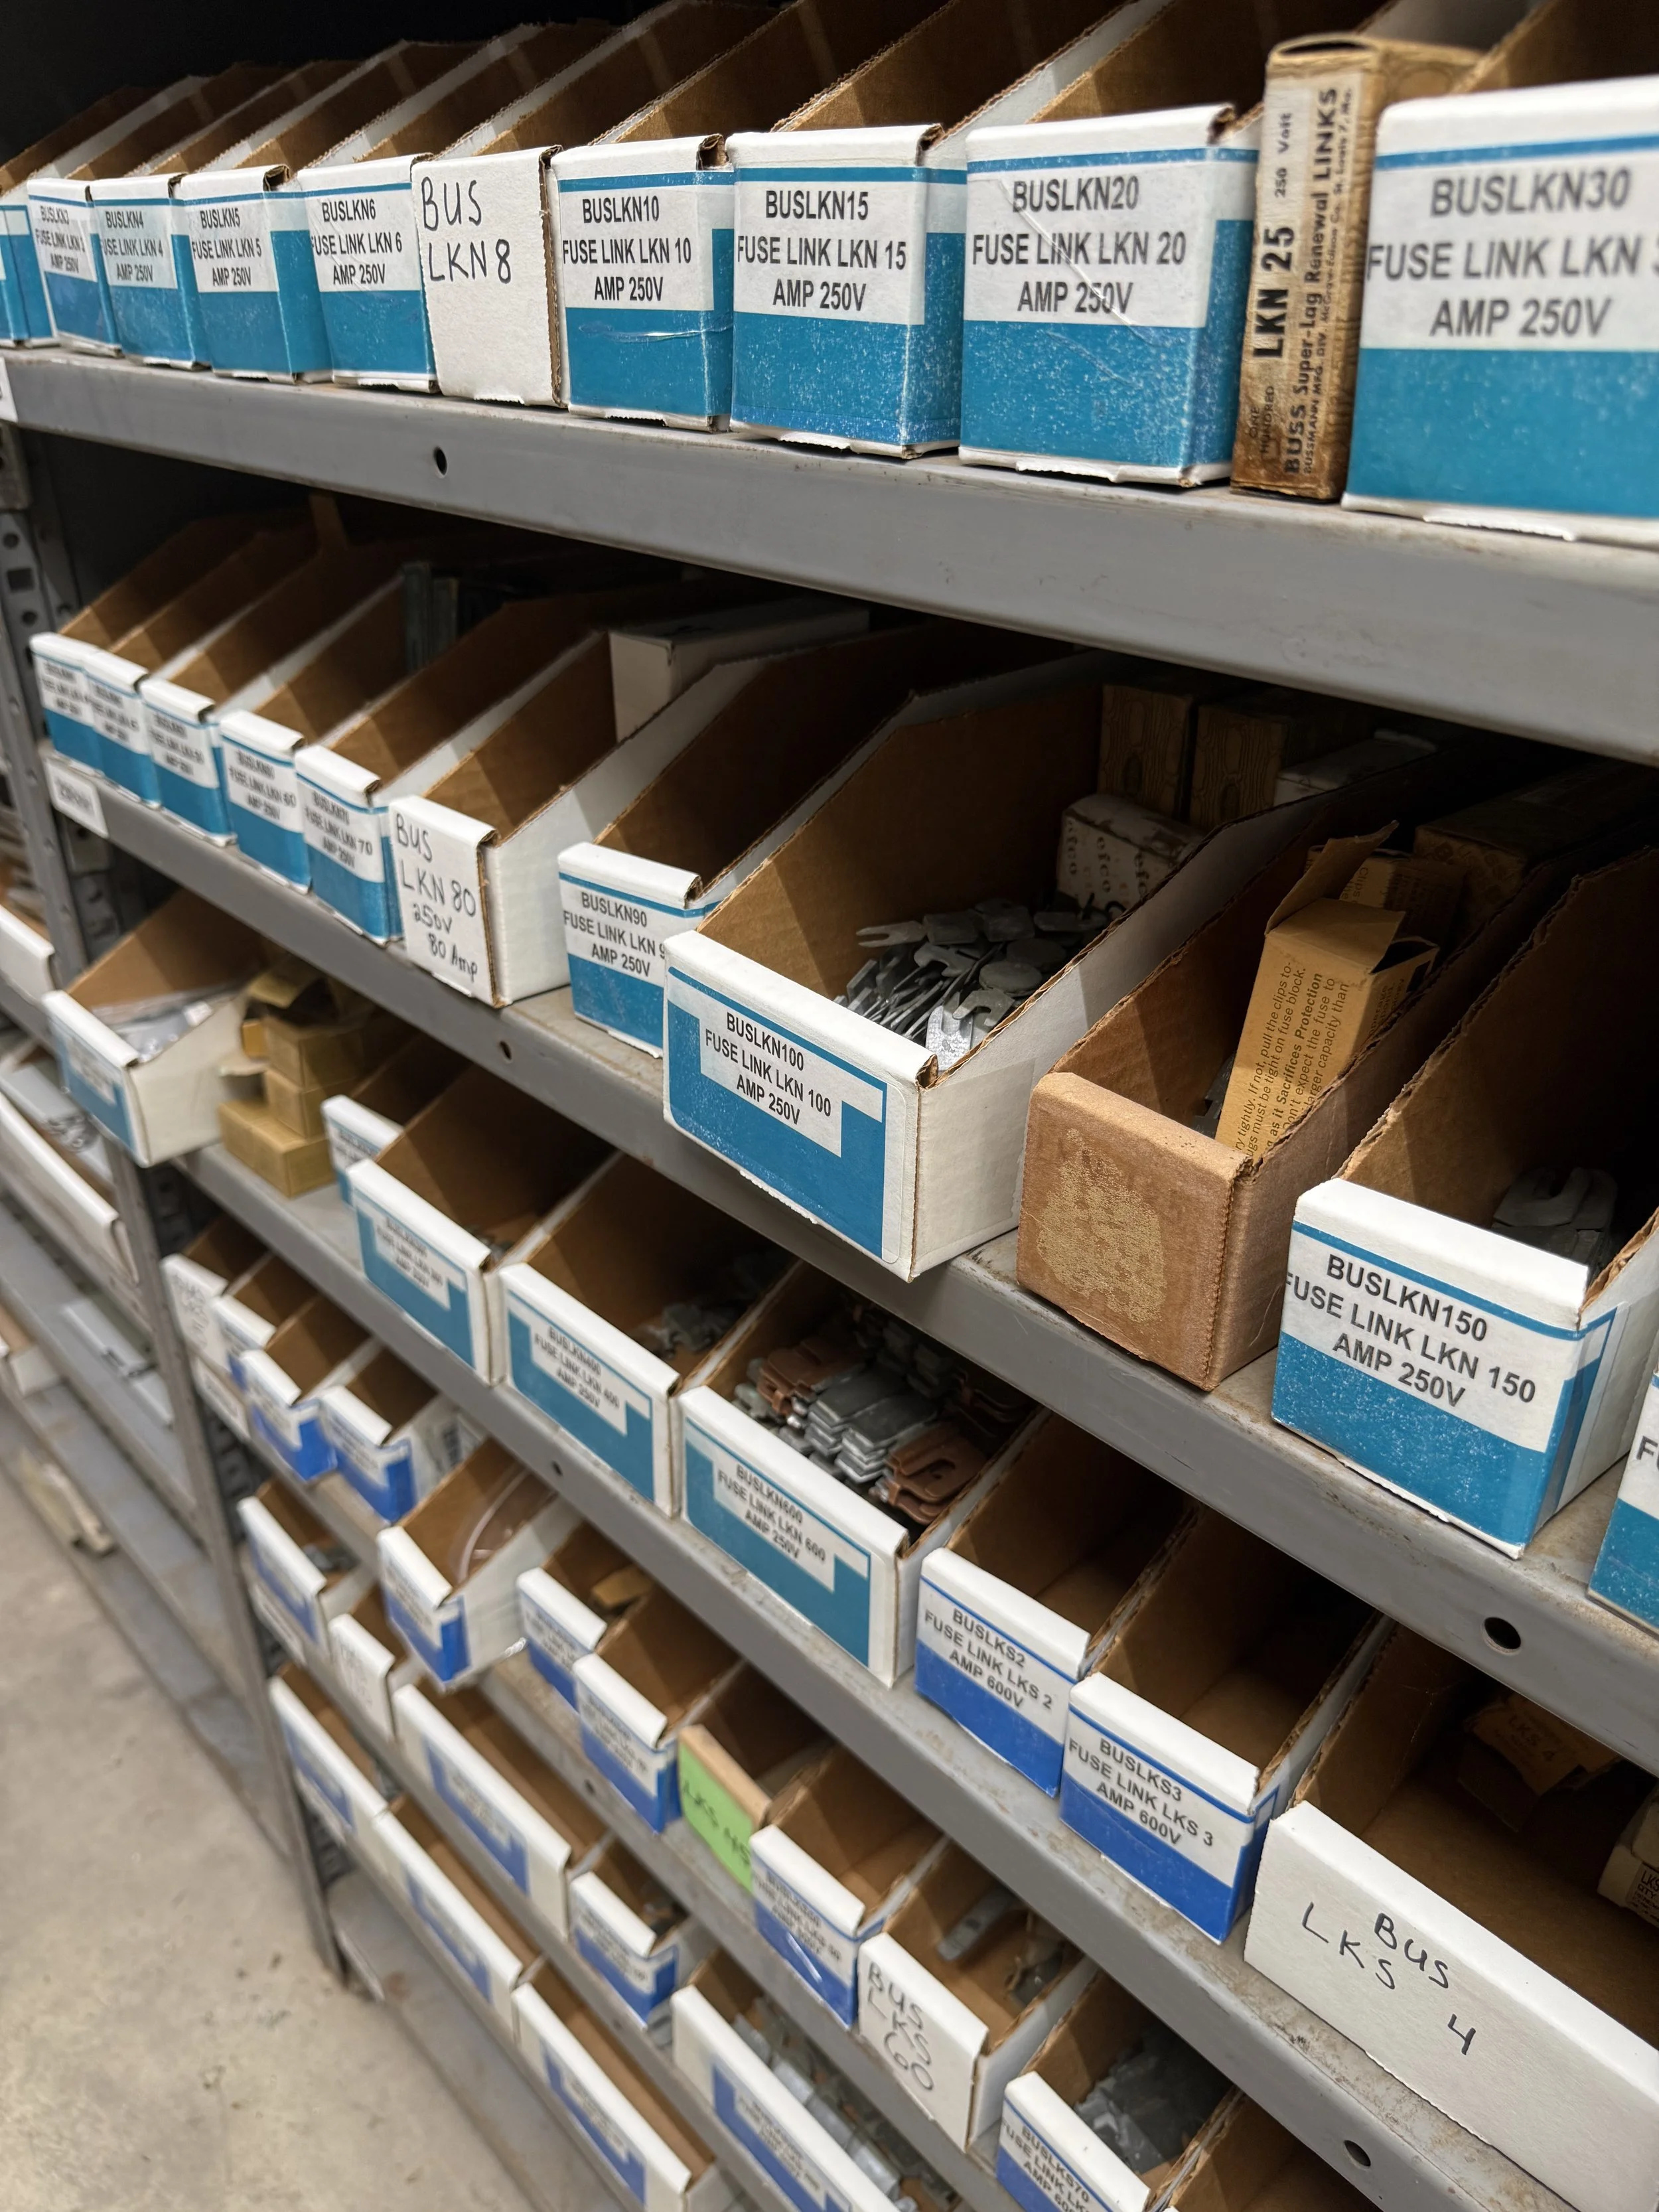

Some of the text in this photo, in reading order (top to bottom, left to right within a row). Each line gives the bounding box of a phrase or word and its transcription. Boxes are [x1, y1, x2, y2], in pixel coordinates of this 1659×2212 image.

[322, 198, 376, 222] BUSLKN6
[421, 176, 482, 232] BUS
[583, 195, 660, 224] BUSLKN10
[766, 189, 869, 220] BUSLKN15
[1012, 175, 1139, 213] BUSLKN20
[1429, 167, 1632, 217] BUSLKN30
[106, 210, 143, 229] BUSLKN4
[200, 207, 240, 229] BUSLKN5
[1253, 112, 1295, 358] LKN 25 250 Volt
[51, 231, 66, 248] LINK
[66, 234, 80, 250] LKN
[119, 240, 138, 256] LINK
[139, 240, 157, 257] LKN
[158, 242, 163, 258] 4
[192, 238, 262, 259] FUSE LINK LKN 5
[338, 233, 366, 255] LINK
[368, 232, 393, 254] LKN
[396, 232, 402, 252] 6
[562, 237, 691, 265] FUSE LINK LKN 10
[737, 235, 907, 270] FUSE LINK LKN 15
[972, 230, 1187, 266] FUSE LINK LKN 20
[1366, 242, 1453, 282] FUSE
[1464, 240, 1548, 279] LINK
[1560, 236, 1642, 276] LKN
[117, 265, 153, 281] AMP 250V
[212, 267, 252, 286] AMP 250V
[333, 263, 386, 285] AMP 250V
[595, 275, 664, 301] AMP 250V
[1284, 88, 1338, 474] BUSS Super-Lag Renewal LINKS
[772, 278, 867, 311] AMP 250V
[1017, 281, 1133, 314] AMP 250V
[1429, 297, 1613, 337] AMP 250V
[1303, 400, 1320, 475] BUSSMANN
[396, 812, 433, 863] BUS
[400, 859, 477, 917] LKN 80
[581, 891, 648, 928] BUSLKN90
[563, 911, 656, 957] FUSE LINK LKN
[427, 932, 478, 983] 80 Amp
[591, 942, 651, 978] AMP 250V
[1272, 980, 1287, 1011] clips
[1323, 978, 1335, 992] to
[1265, 1010, 1279, 1033] the
[1294, 973, 1323, 1041] Protection
[1313, 995, 1331, 1025] fuse
[1318, 1013, 1342, 1069] capacity
[1332, 983, 1350, 1014] than
[726, 1011, 805, 1072] BUSLKN100
[1252, 968, 1306, 1132] must be tight on fuse block.
[1261, 1032, 1273, 1058] pull
[1307, 1029, 1321, 1051] the
[705, 1029, 832, 1118] FUSE LINK LKN 100
[1248, 1082, 1258, 1095] If
[1253, 1061, 1266, 1082] not,
[1276, 1044, 1303, 1105] Sacrifices
[1295, 1053, 1314, 1096] expect
[736, 1073, 801, 1126] AMP 250V
[1238, 1098, 1256, 1137] tightly.
[1271, 1108, 1284, 1119] it
[1269, 1120, 1281, 1137] as
[1326, 1253, 1488, 1342] BUSLKN150
[1333, 1332, 1467, 1408] AMP 250V
[1350, 1302, 1416, 1351] LINK
[1420, 1334, 1479, 1380] LKN
[1489, 1365, 1536, 1404] 150
[736, 1463, 804, 1524] BUSLKN600
[717, 1469, 826, 1562] FUSE LINK LKN 600
[745, 1509, 800, 1559] AMP 250V
[952, 1607, 1026, 1668] BUSLKS2
[924, 1609, 1052, 1710] FUSE LINK LKS 2
[949, 1647, 1025, 1710] AMP 600V
[1099, 1737, 1183, 1803] BUSLKS3
[1068, 1737, 1214, 1848] FUSE LINK LKS 3
[1096, 1781, 1183, 1848] AMP 600V
[868, 1960, 924, 2031] BUS
[1301, 1901, 1477, 2055] LKS 4
[867, 1986, 932, 2065] LKS
[1021, 2125, 1090, 2203] BUSLKS70
[1023, 2160, 1052, 2192] AMP
[1033, 2155, 1064, 2193] LINK
